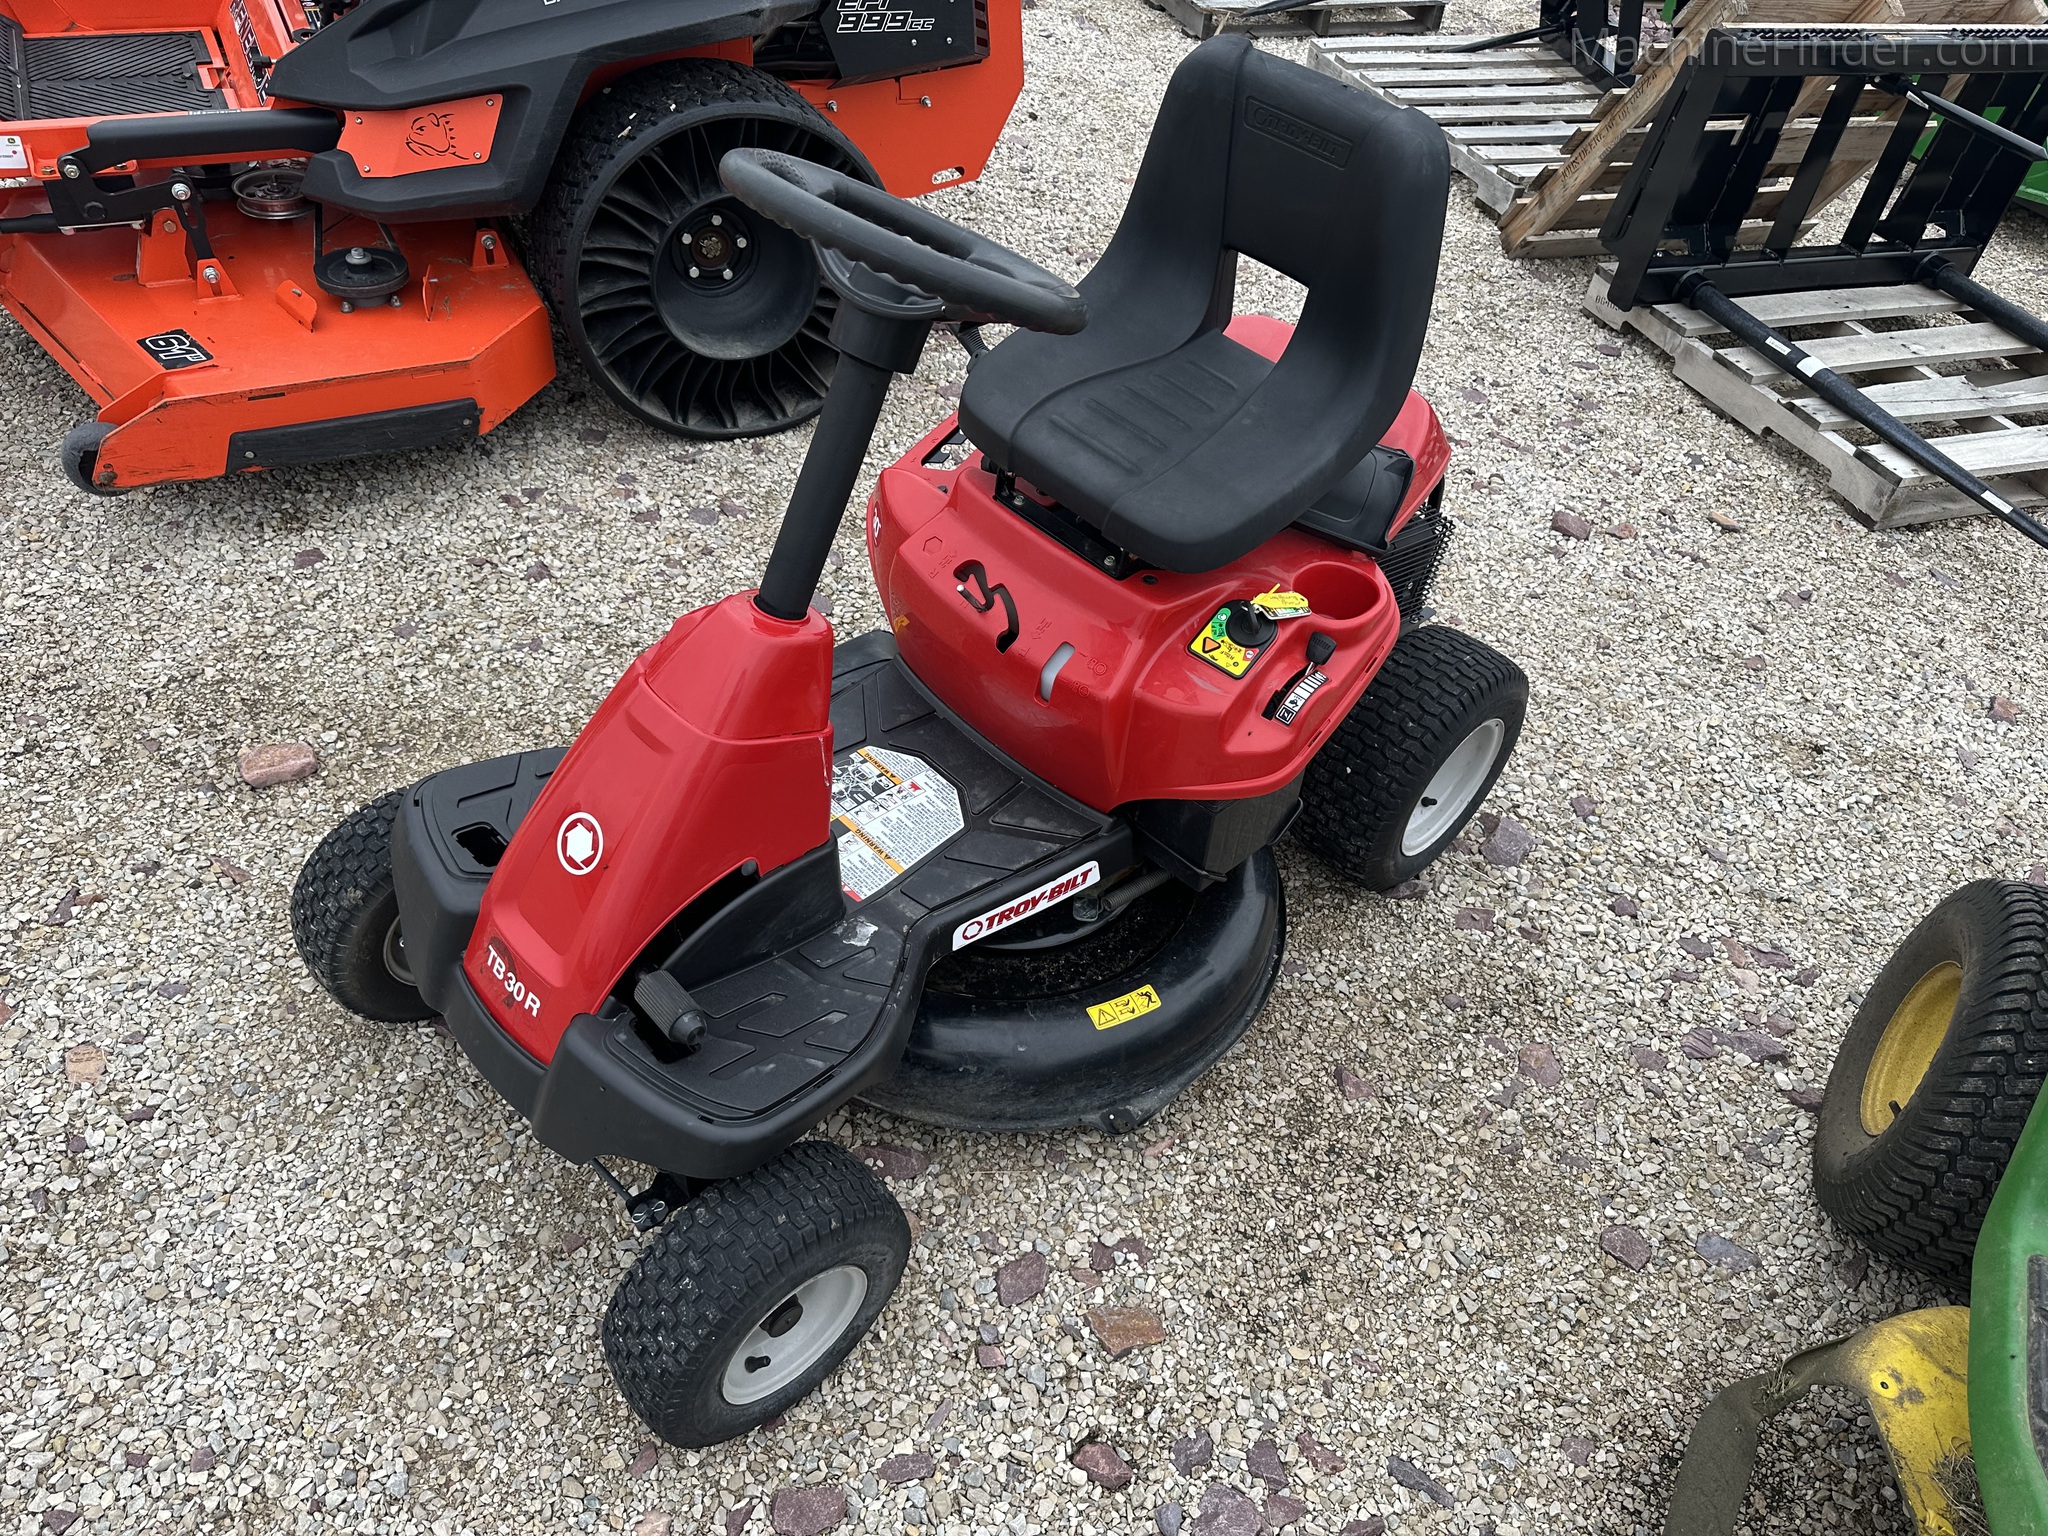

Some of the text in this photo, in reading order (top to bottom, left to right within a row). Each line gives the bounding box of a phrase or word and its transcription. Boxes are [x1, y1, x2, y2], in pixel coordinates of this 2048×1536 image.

[836, 10, 935, 33] 999cc
[863, 753, 891, 775] WARNING
[854, 828, 885, 856] WARNING
[985, 867, 1093, 932] TROY-BILT
